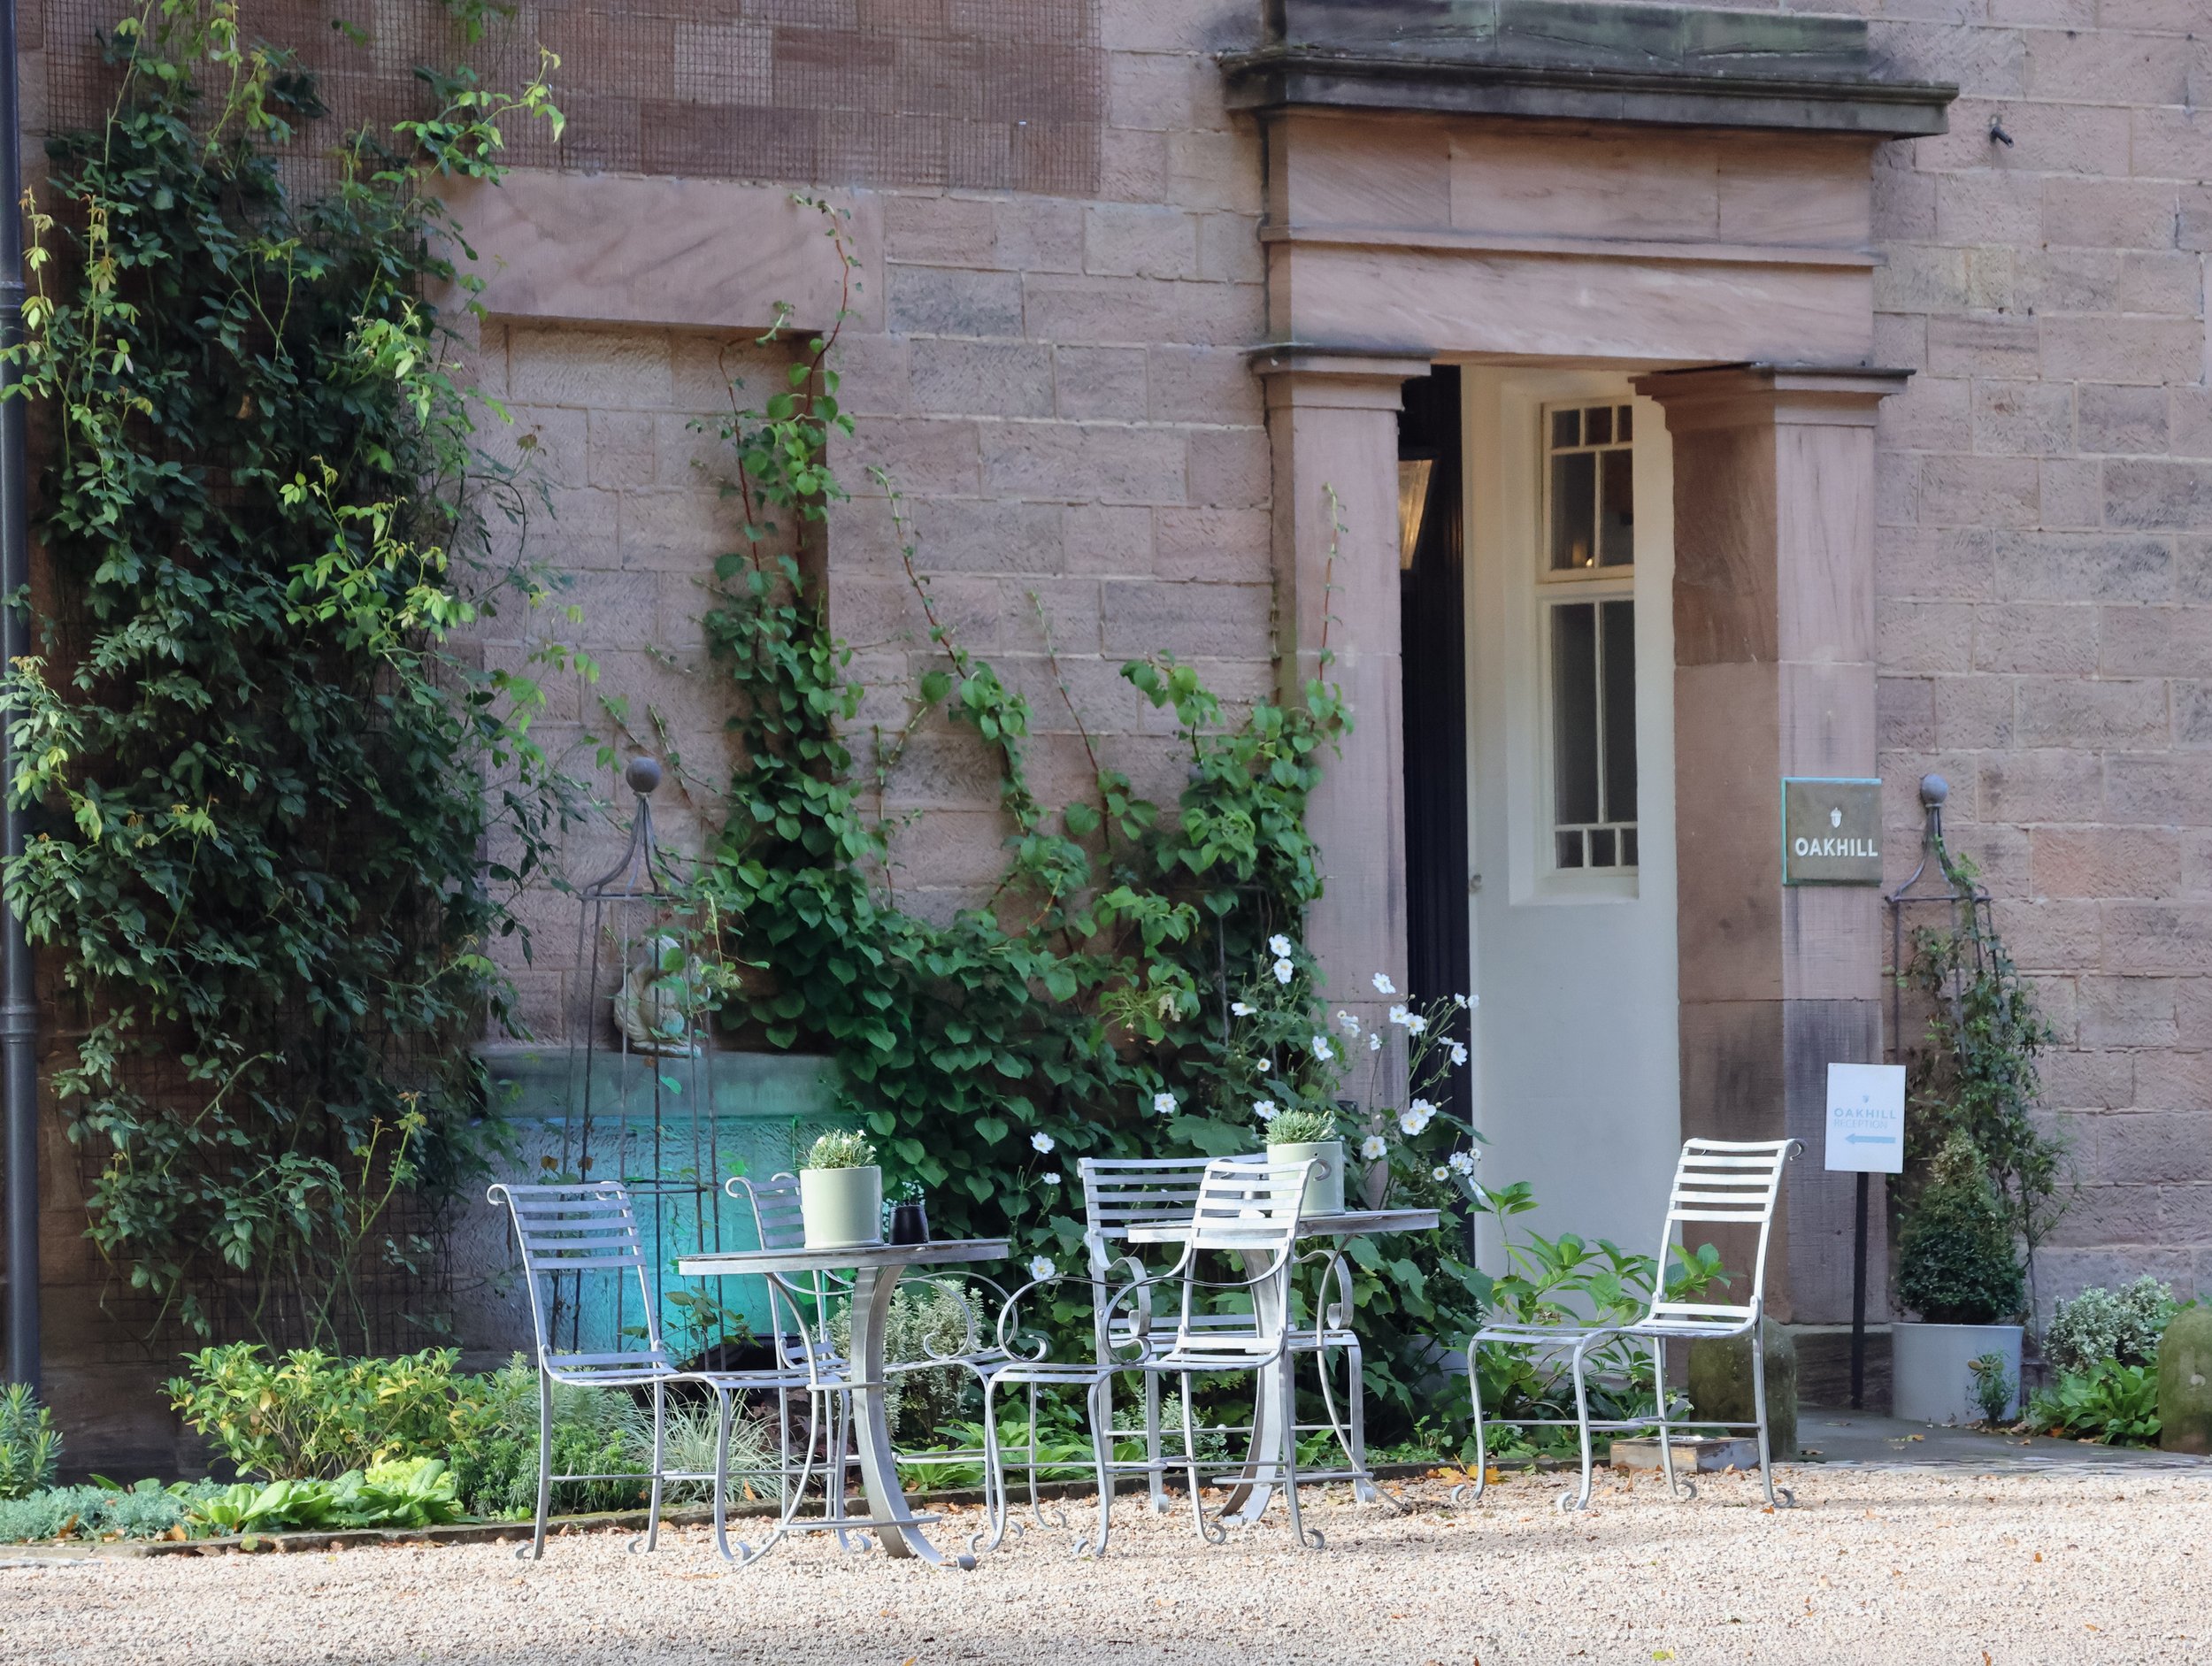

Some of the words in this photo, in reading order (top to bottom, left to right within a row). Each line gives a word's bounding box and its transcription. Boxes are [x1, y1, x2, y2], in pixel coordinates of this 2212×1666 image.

[1795, 837, 1878, 856] OAKHILL
[1834, 1108, 1896, 1119] OAKHILL
[1834, 1118, 1888, 1129] RECEPTION
